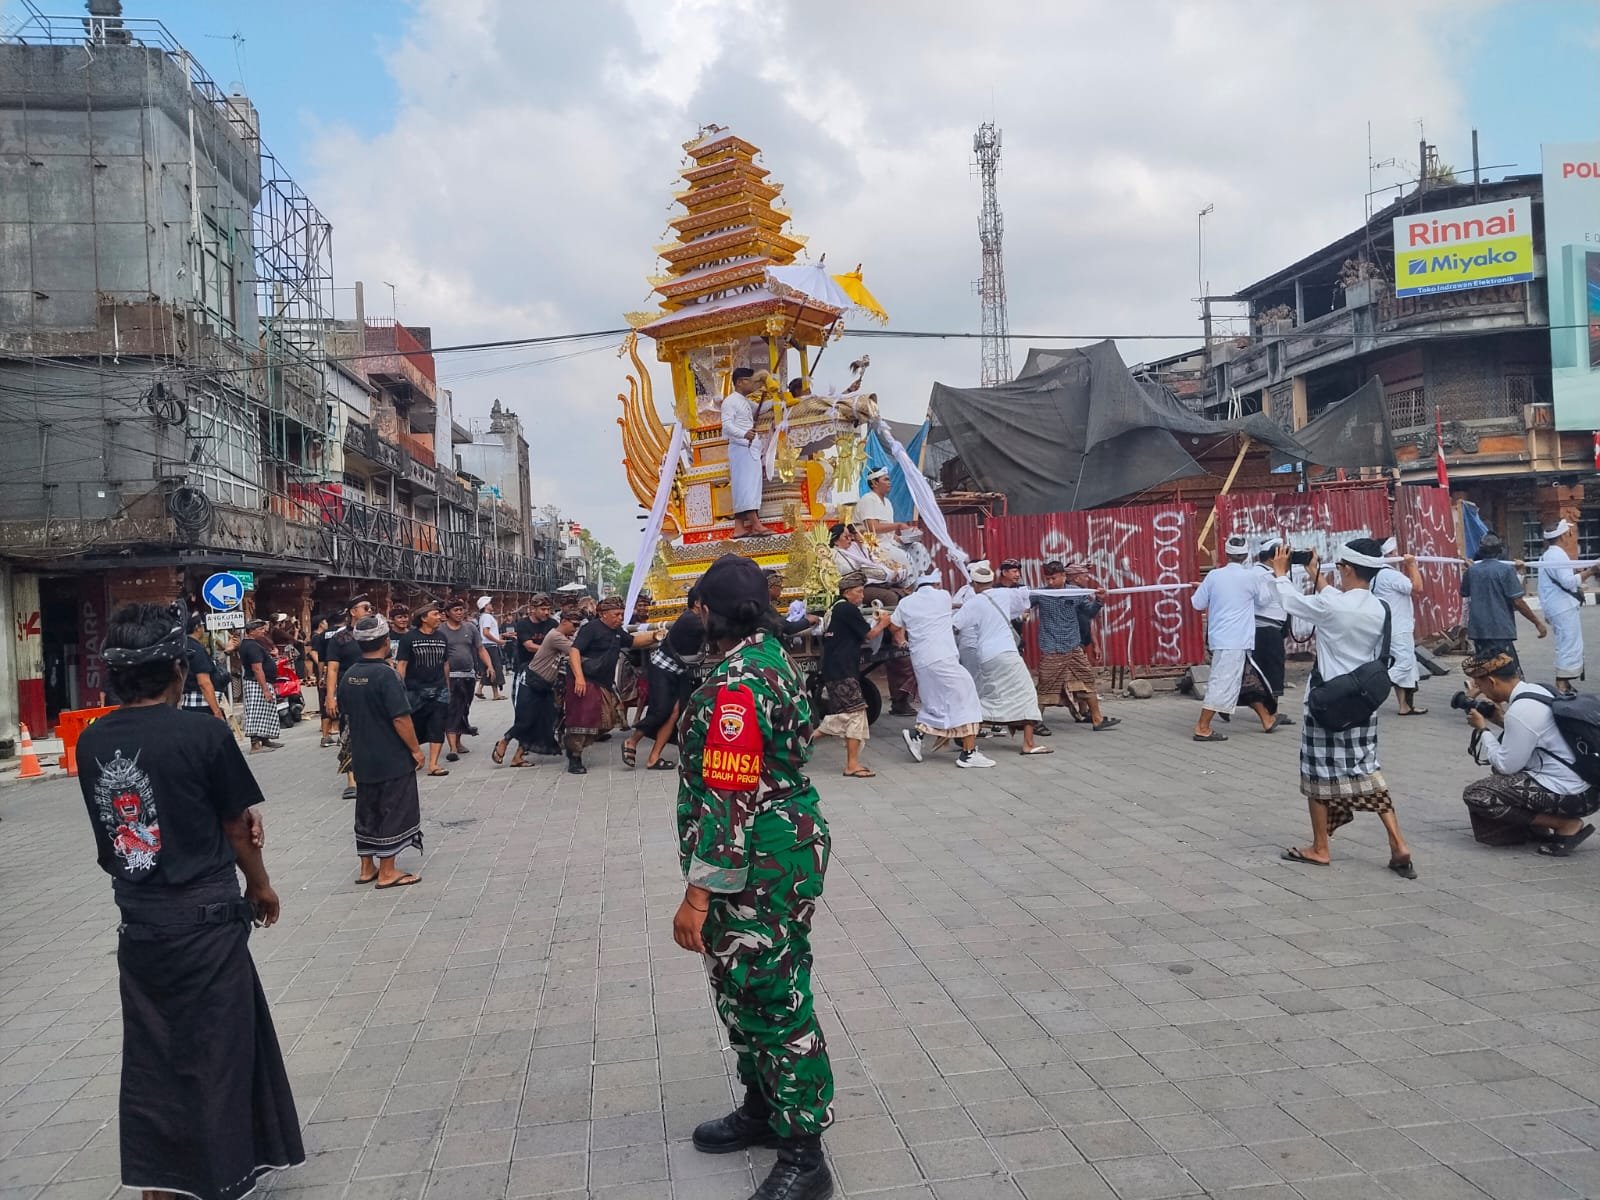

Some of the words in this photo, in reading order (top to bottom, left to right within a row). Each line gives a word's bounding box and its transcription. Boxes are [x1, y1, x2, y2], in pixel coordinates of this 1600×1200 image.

[1409, 208, 1515, 246] Rinnai
[1431, 248, 1517, 274] Miyako
[1418, 286, 1437, 294] Toko
[1473, 275, 1515, 287] Elektronik
[83, 602, 101, 688] SHARP
